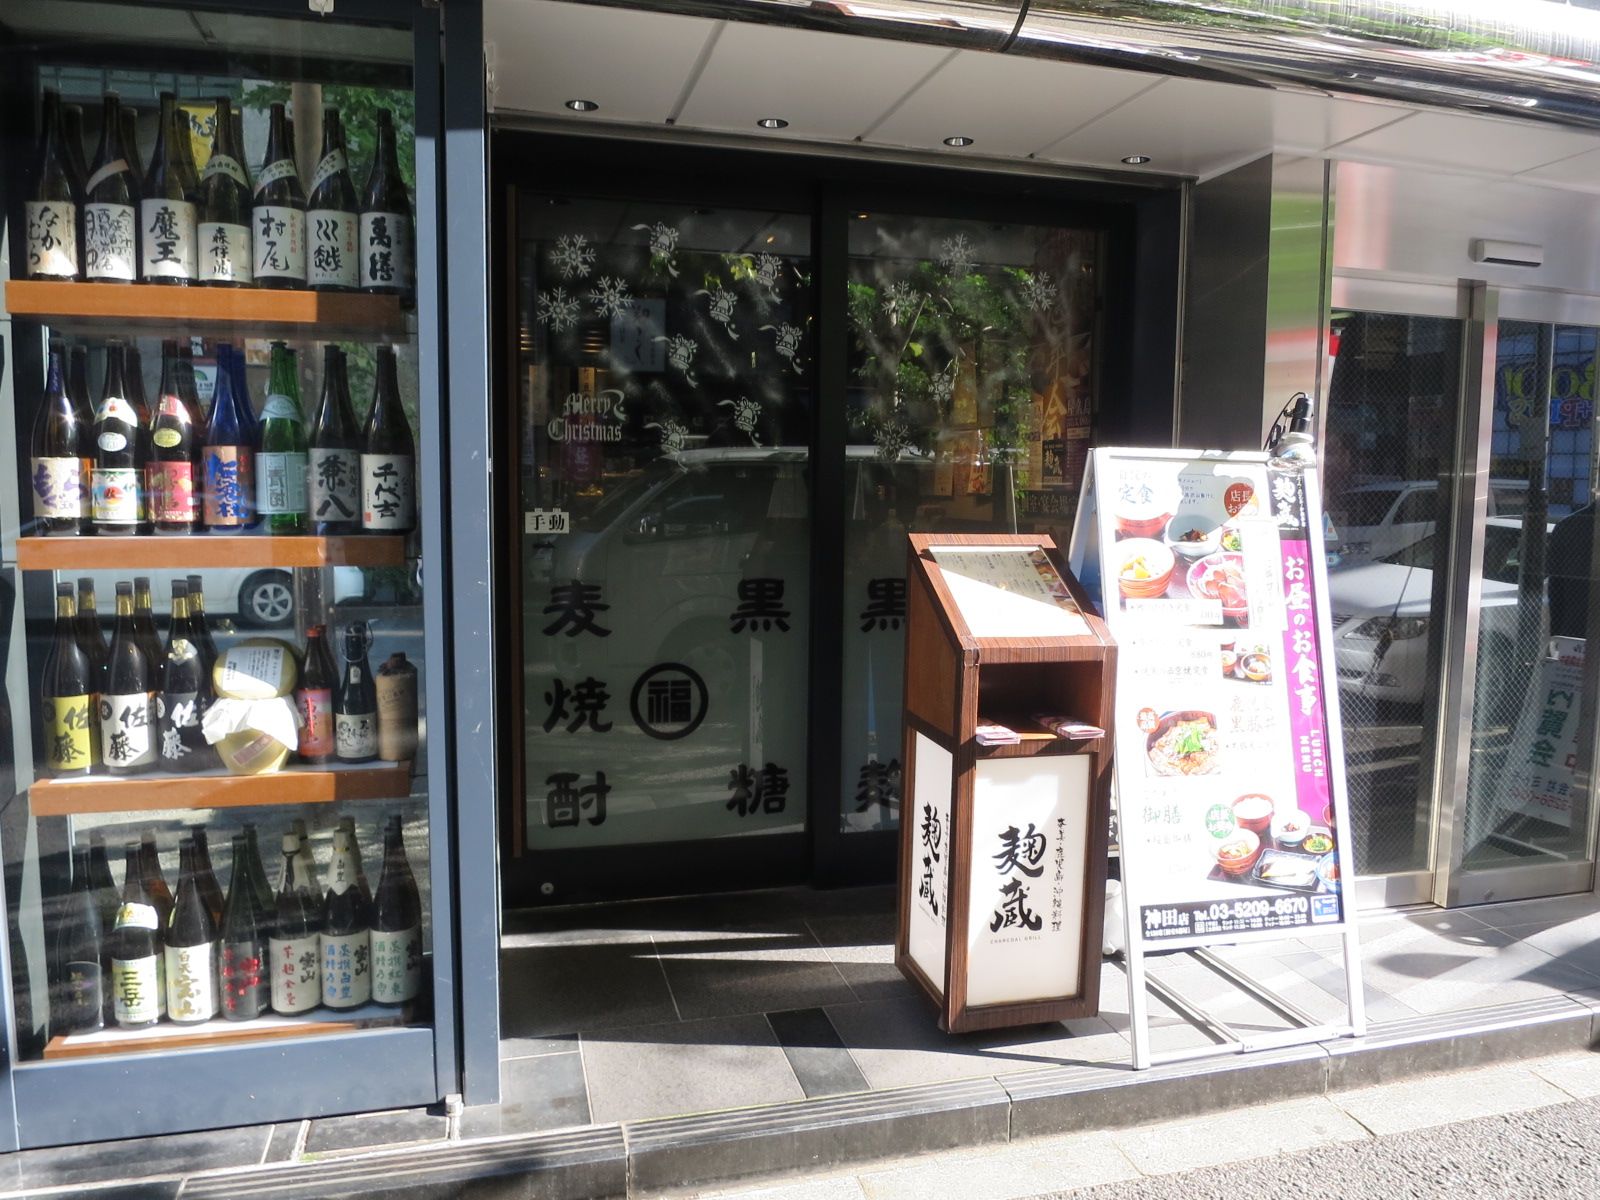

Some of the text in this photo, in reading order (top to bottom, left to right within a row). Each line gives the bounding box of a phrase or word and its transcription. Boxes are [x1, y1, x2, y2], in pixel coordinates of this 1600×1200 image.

[149, 206, 181, 264] 魔王
[259, 208, 290, 271] 村尾
[313, 218, 344, 273] 川越
[548, 419, 623, 443] Christmas
[562, 391, 612, 420] Merry
[316, 454, 355, 519] 兼八
[372, 463, 402, 519] 千代吉
[1118, 483, 1155, 505] 定食
[531, 513, 566, 532] 手動
[542, 579, 614, 829] 麦焼酎
[647, 679, 692, 724] 福
[725, 576, 792, 818] 黒糖
[52, 702, 90, 764] 佐藤
[108, 704, 150, 762] 佐藤
[162, 699, 200, 760] 佐藤
[1299, 735, 1314, 774] MENU
[1310, 729, 1325, 778] LUNCH
[989, 823, 1048, 934] 麹蔵
[1145, 908, 1190, 929] 神田店
[120, 970, 144, 1008] 三岳
